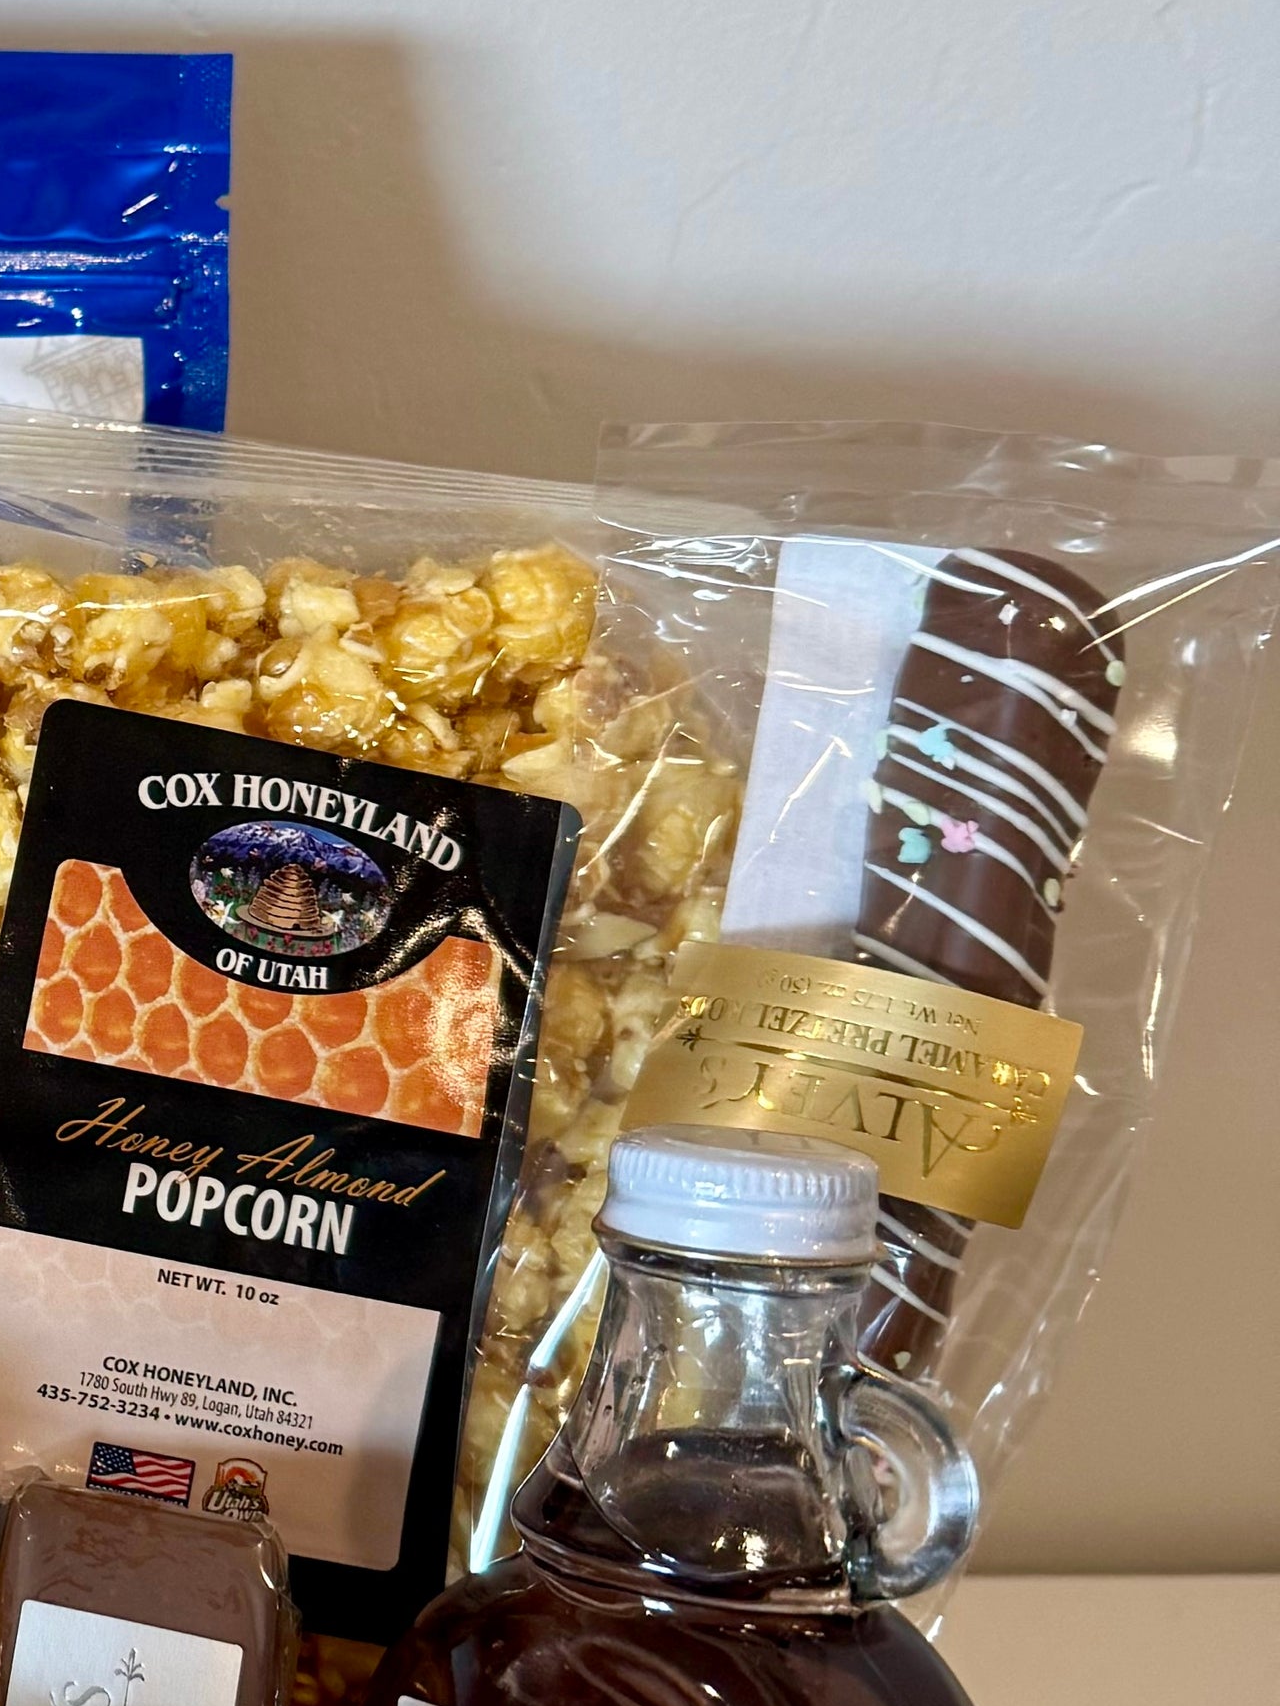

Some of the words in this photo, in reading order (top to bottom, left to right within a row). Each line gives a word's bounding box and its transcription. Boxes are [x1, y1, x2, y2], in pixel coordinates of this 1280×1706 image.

[138, 772, 221, 811] COX
[232, 773, 463, 873] HONEYLAND
[216, 948, 251, 978] OF
[256, 953, 329, 991] UTAH
[900, 1033, 1052, 1098] CARAMEL
[56, 1097, 224, 1185] Honey
[236, 1134, 446, 1207] Almond
[121, 1162, 354, 1255] POPCORN
[157, 1268, 192, 1288] NET
[194, 1275, 228, 1295] WT.
[234, 1283, 256, 1301] 10
[258, 1291, 280, 1305] oz
[78, 1371, 110, 1391] 1780
[110, 1377, 148, 1398] South
[149, 1386, 178, 1408] Hwy
[179, 1392, 201, 1411] 89,
[201, 1395, 243, 1420] Logan,
[244, 1403, 275, 1423] Utah
[275, 1409, 314, 1430] 84321
[102, 1354, 139, 1376] COX
[142, 1363, 259, 1402] HONEYLAND,
[261, 1386, 299, 1407] INC.
[35, 1382, 161, 1421] 435-752-3234
[173, 1409, 344, 1459] www.coxhoney.com
